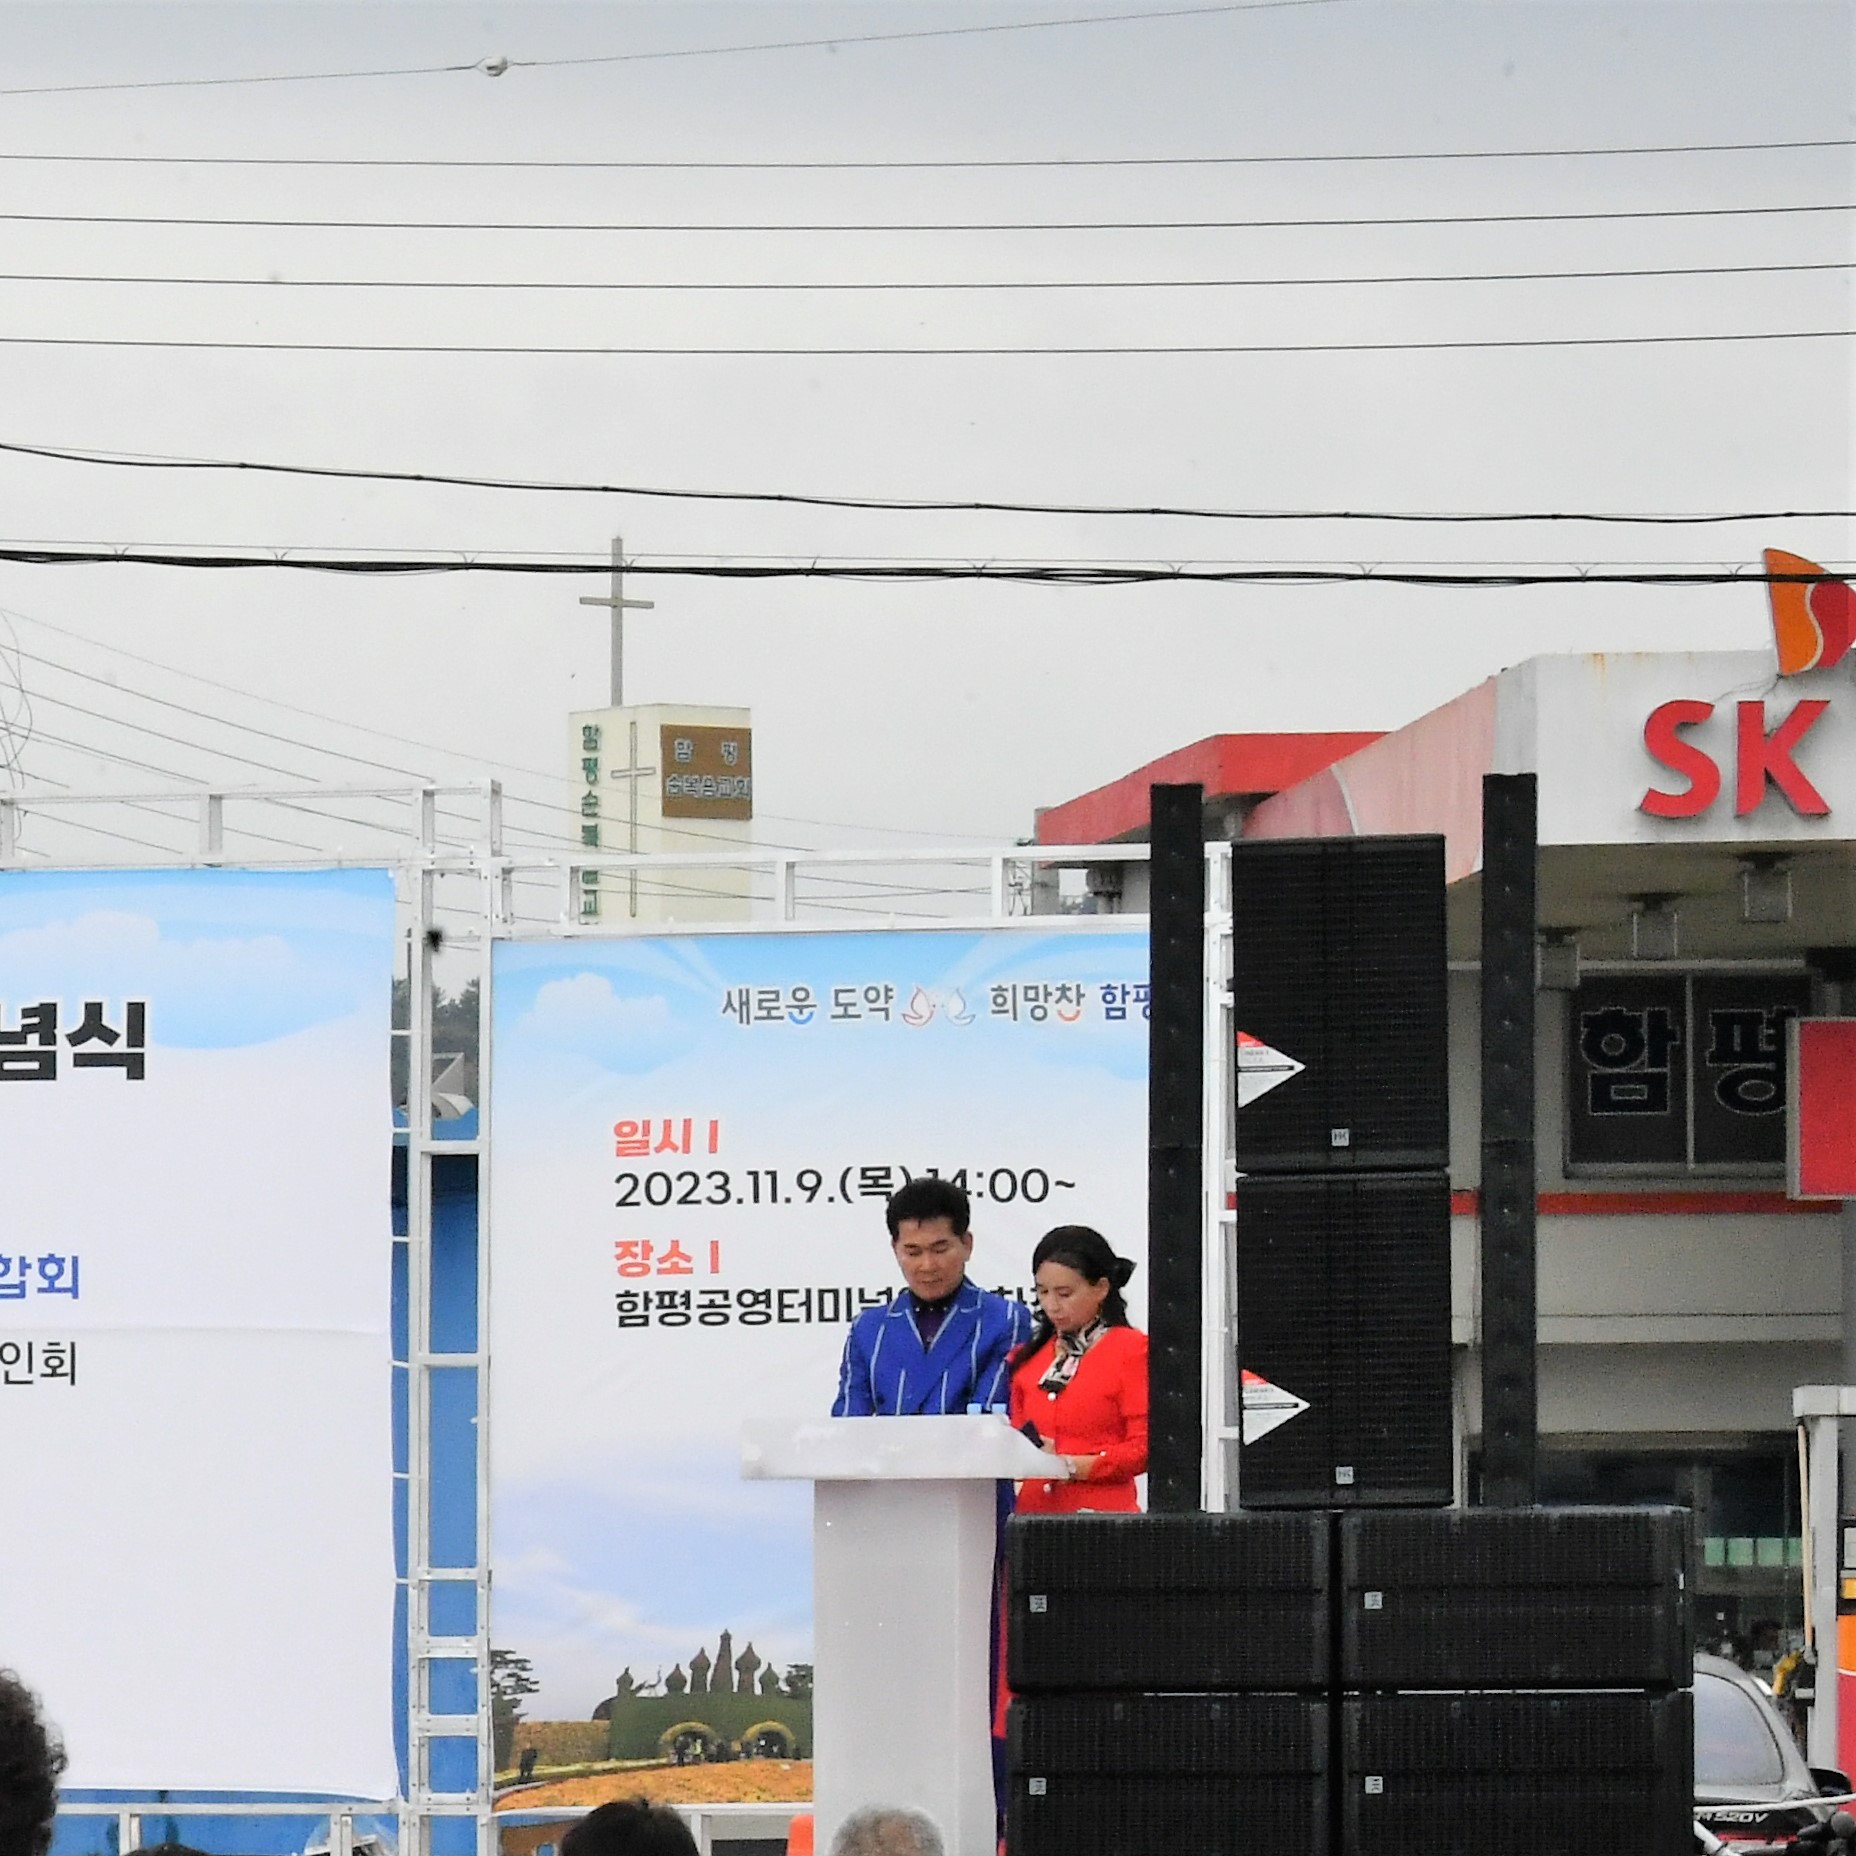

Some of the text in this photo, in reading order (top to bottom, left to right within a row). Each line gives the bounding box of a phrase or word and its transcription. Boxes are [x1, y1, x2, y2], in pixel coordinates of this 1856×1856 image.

[1638, 699, 1832, 819] SK
[722, 984, 817, 1025] 새로운
[830, 984, 894, 1022] 도약
[990, 982, 1086, 1023] 희망찬
[613, 1117, 693, 1158] 일시
[613, 1238, 694, 1277] 장소
